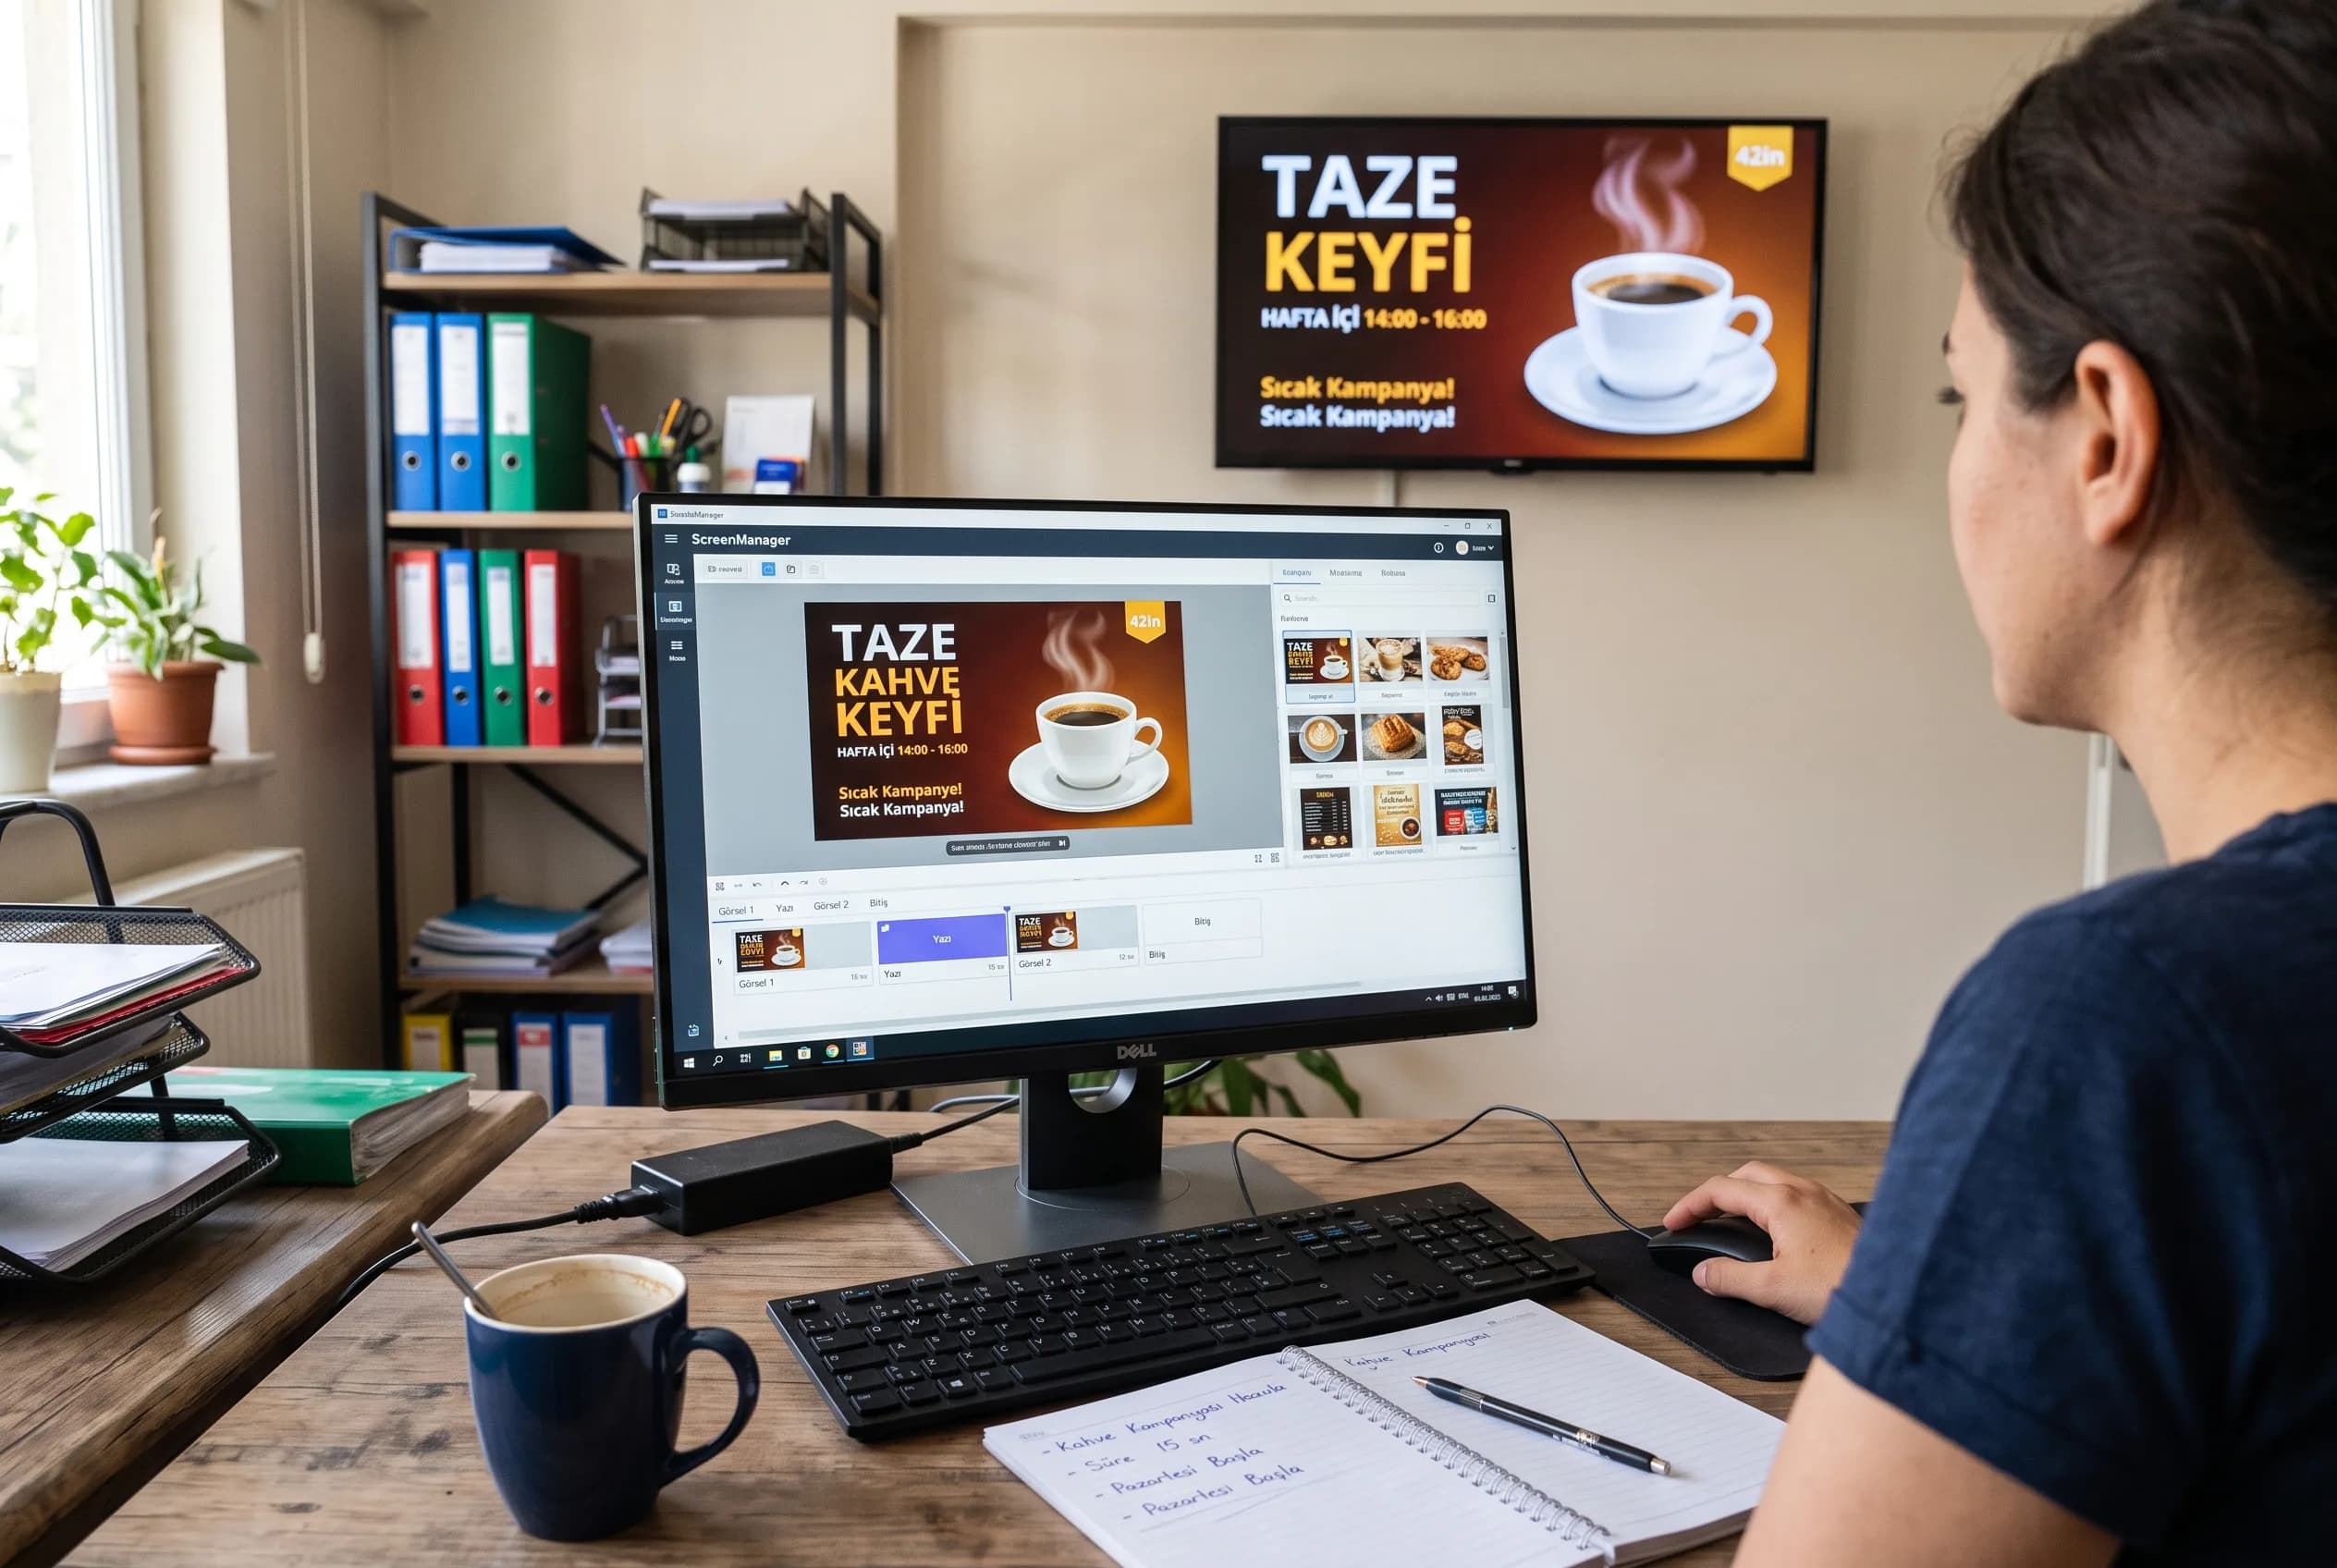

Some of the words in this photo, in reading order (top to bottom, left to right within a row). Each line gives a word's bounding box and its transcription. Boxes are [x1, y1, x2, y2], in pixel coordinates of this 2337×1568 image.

[1261, 154, 1458, 219] TAZE
[1266, 215, 1472, 293] KEYFİ
[1260, 307, 1330, 329] HAFTA
[1331, 303, 1361, 334] İÇİ
[1364, 308, 1418, 329] 14:00
[1432, 308, 1487, 330] 16:00
[1260, 374, 1322, 398] Sıcak
[1326, 376, 1455, 405] Kampanya!
[1260, 403, 1322, 427] Sıcak
[1326, 405, 1456, 433] Kampanya!
[691, 533, 791, 547] ScreenManager
[1130, 615, 1161, 628] 42in
[832, 623, 957, 662] TAZE
[1287, 642, 1313, 652] TAZE
[835, 667, 960, 697] KAHVE
[837, 691, 962, 737] KEYFİ
[837, 746, 877, 758] HAFTA
[879, 743, 895, 759] İÇİ
[897, 744, 928, 755] 14:00
[937, 743, 969, 754] 16:00
[838, 785, 878, 800] Sıcak
[839, 802, 880, 818] Sıcak
[883, 800, 964, 818] Kampanya!
[814, 900, 841, 911] Görsel
[843, 900, 850, 909] 2
[1046, 958, 1051, 966] 2
[1117, 1043, 1157, 1060] DELL
[1056, 1433, 1117, 1452] Kahve
[1125, 1403, 1224, 1434] Kampanyası
[1084, 1455, 1135, 1472] Süre
[1156, 1439, 1180, 1452] 15
[1189, 1434, 1212, 1445] sn
[1110, 1464, 1198, 1495] Pazartesi
[1206, 1446, 1265, 1468] Başla
[1142, 1484, 1234, 1516] Pazartesi
[1243, 1464, 1305, 1486] Başla
